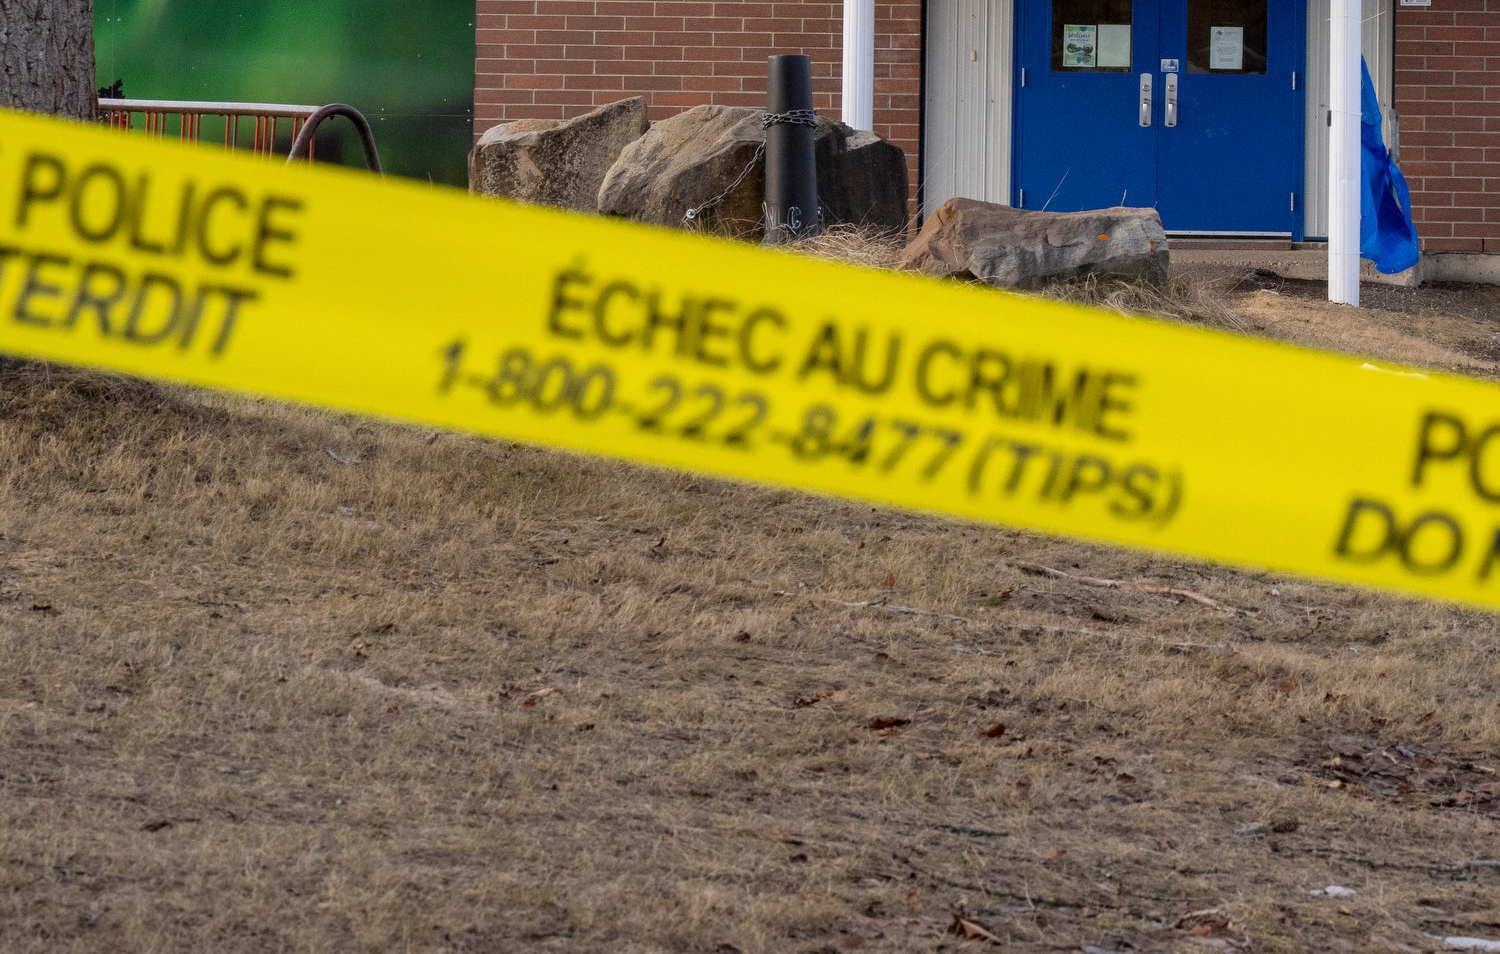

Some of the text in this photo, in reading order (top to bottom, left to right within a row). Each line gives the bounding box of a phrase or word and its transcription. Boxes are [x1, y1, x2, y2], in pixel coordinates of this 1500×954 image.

[14, 150, 306, 280] POLICE
[546, 252, 1140, 443] ÉCHEC AU CRIME
[1334, 498, 1465, 576] DO
